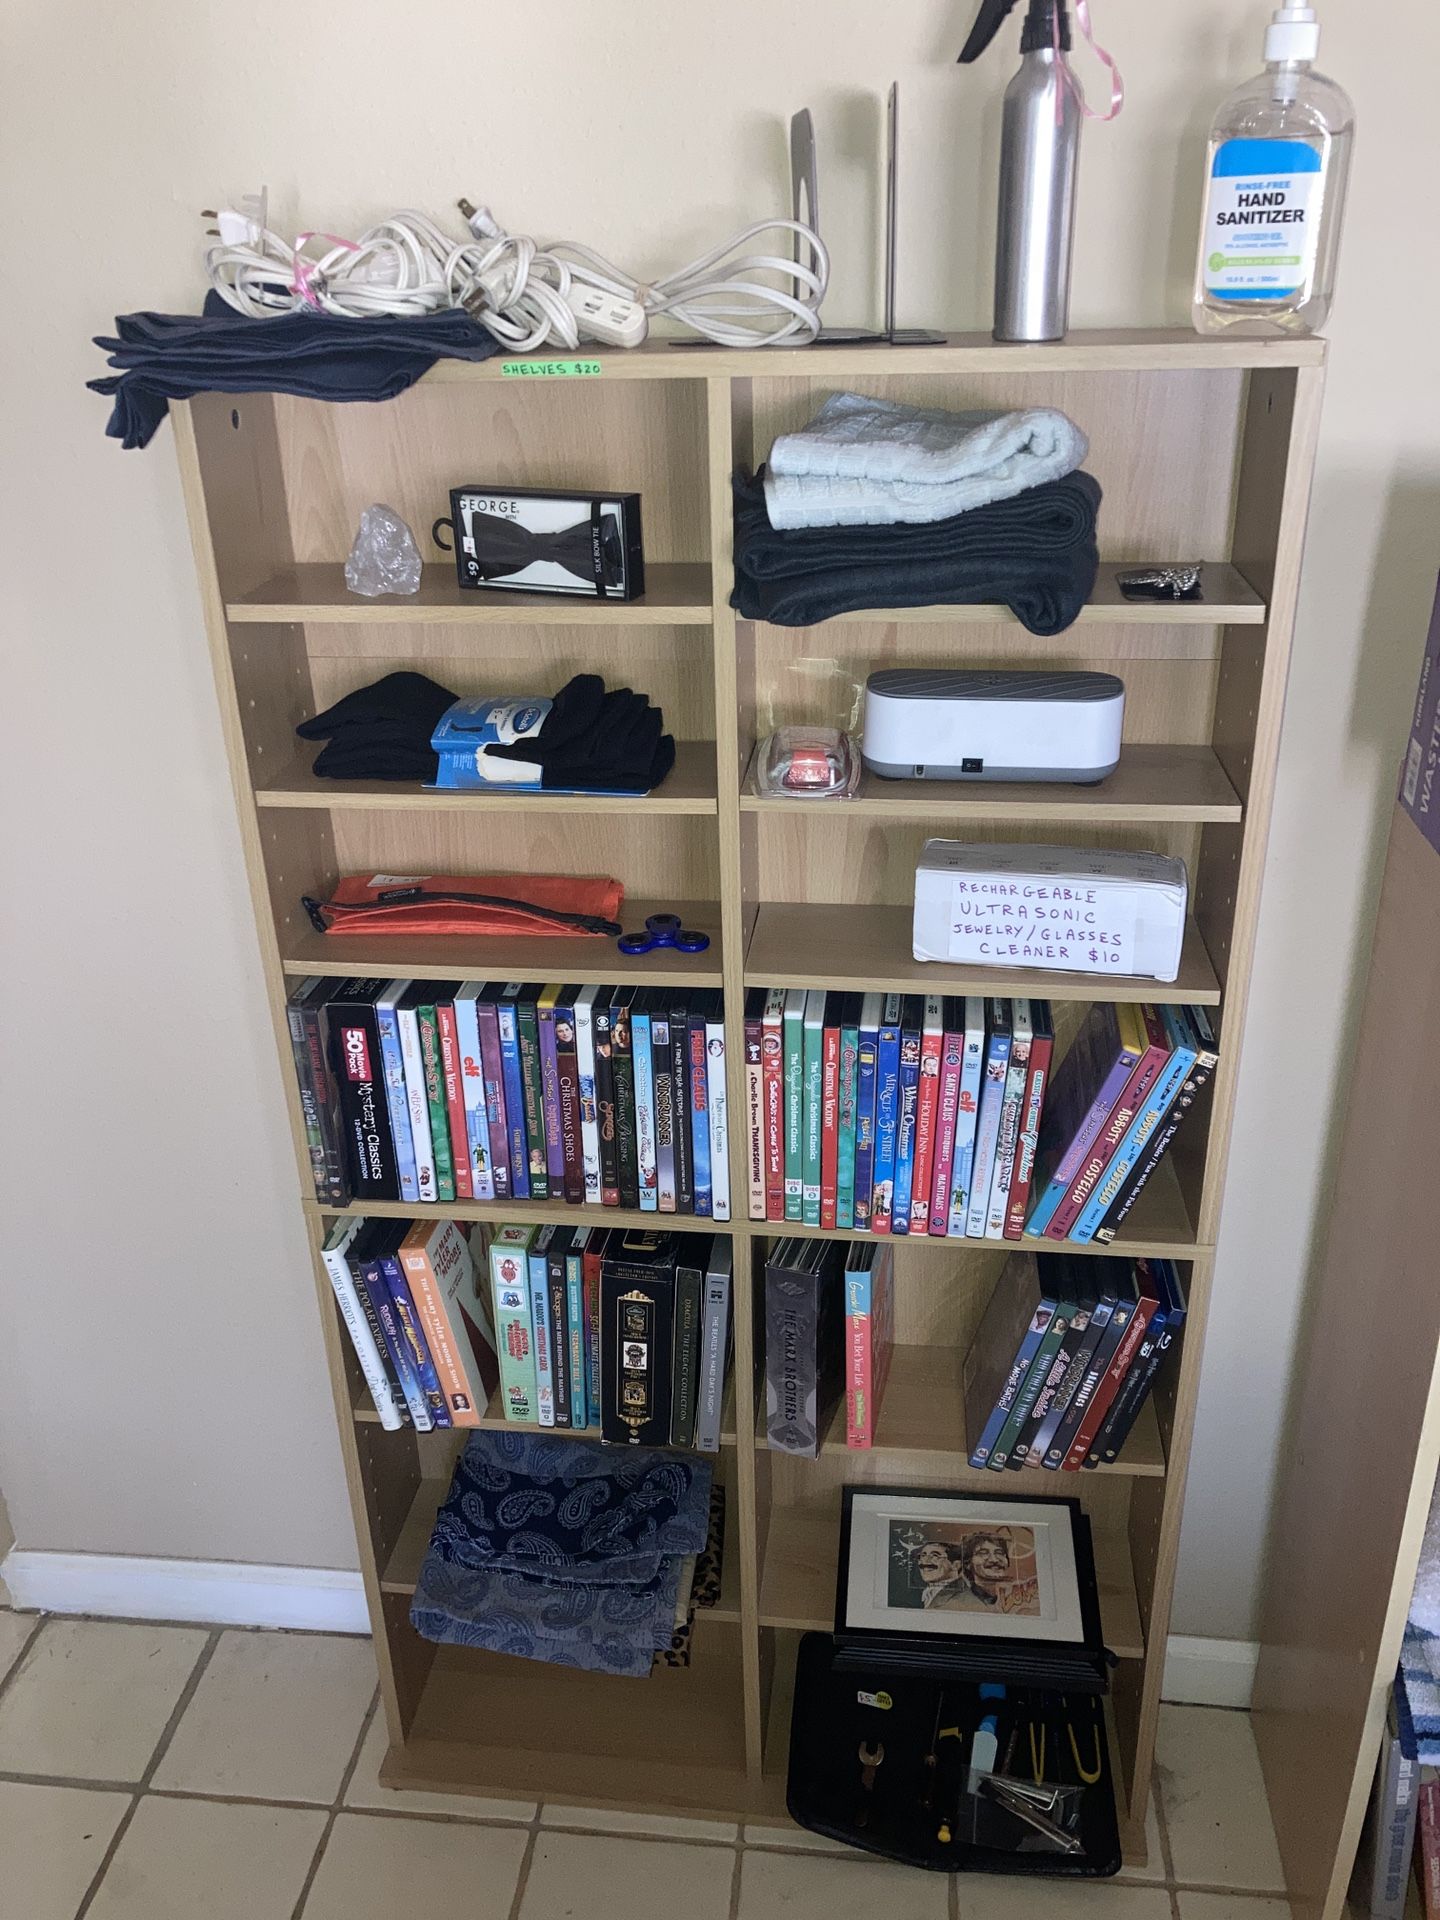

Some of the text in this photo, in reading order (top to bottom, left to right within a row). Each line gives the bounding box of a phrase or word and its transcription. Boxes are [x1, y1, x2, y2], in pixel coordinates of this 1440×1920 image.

[1235, 181, 1291, 191] RINSE-FREE
[1238, 192, 1285, 207] HAND
[1216, 209, 1305, 226] SANITIZER
[502, 363, 600, 374] SHELVES $20
[459, 498, 517, 514] GEORGE
[592, 526, 600, 540] TIE
[593, 540, 601, 556] BOW
[1415, 655, 1431, 728] KIRKLAND
[959, 882, 1096, 904] RECHARGEABLE
[960, 903, 1096, 923] ULTRASONIC
[953, 923, 1122, 946] JEWELRY/GLASSES
[979, 942, 1120, 963] CLEANER $10
[346, 1029, 364, 1053] 50
[347, 1052, 358, 1074] Pack
[356, 1053, 366, 1079] Movie
[441, 1037, 457, 1102] CHRISTMAS VACATION
[463, 1056, 478, 1077] elf
[690, 1029, 708, 1112] FRED CLAUS
[523, 1055, 539, 1136] WILLIAMS CHRISTMAS SHOW
[544, 1068, 557, 1102] SIMPSONS
[824, 1061, 837, 1128] CHRISTMAS VACATION
[903, 1085, 917, 1113] White
[614, 1071, 631, 1162] CHRISTMAS BLESSING
[656, 1073, 672, 1146] WINDRUNNER
[790, 1053, 799, 1155] The Christmas Classics
[809, 1061, 819, 1162] The Christmas Classics
[879, 1072, 896, 1164] MIRACLE STREET
[919, 1100, 932, 1136] HOLIDAY
[959, 1090, 977, 1114] elf
[357, 1082, 383, 1180] Mystery Classics
[559, 1076, 575, 1162] CHRISTMAS SHOES
[749, 1076, 761, 1183] Charlie Brown THANKSGIVING
[1017, 1070, 1044, 1184] CLASSIC COMEDY Christmas
[1131, 1110, 1159, 1147] ABBOTT
[353, 1118, 368, 1180] 12-DVD COLLECTION
[900, 1114, 915, 1160] Christmas
[918, 1136, 930, 1154] INN
[934, 1072, 957, 1211] SANTA CLAUS conquers MARTIANS
[1072, 1107, 1133, 1204] ABBOTT COSTELLO
[1098, 1160, 1129, 1206] COSTELLO
[1116, 1125, 1178, 1221] The Beatles Fun with the Fab Four
[437, 1222, 454, 1252] MARY
[329, 1267, 344, 1295] JAMES
[352, 1270, 389, 1360] THE POLAR EXPRESS
[379, 1304, 397, 1337] RUDOLPH
[535, 1302, 545, 1326] MAGOO'S
[711, 1315, 720, 1328] THE
[419, 1277, 431, 1294] THE
[425, 1293, 438, 1316] MARY
[432, 1316, 447, 1346] TYLER
[441, 1343, 455, 1370] MOORE
[448, 1368, 461, 1390] SHOW
[536, 1326, 547, 1355] CHRISTMAS
[570, 1328, 580, 1366] STEAMBOAT
[591, 1333, 600, 1362] ULTIMATE
[710, 1328, 719, 1351] BEATLES
[851, 1309, 867, 1386] Marx You Bet Your Life
[538, 1355, 548, 1372] CAROL
[556, 1344, 564, 1367] BEHIND
[679, 1298, 693, 1421] DRACULA THE LEGACY COLLECTION
[709, 1360, 717, 1376] HARD
[784, 1309, 798, 1422] THE MARX BROTHERS
[557, 1378, 565, 1404] MAYHEM
[572, 1367, 581, 1382] BILL
[591, 1362, 600, 1395] COLLECTION
[707, 1376, 716, 1395] DAY'S
[998, 1358, 1030, 1413] No MORE BATHS!
[1031, 1349, 1071, 1419] A Little Inside
[1052, 1350, 1093, 1411] WINDRUNNER
[511, 1406, 530, 1415] DVD
[706, 1394, 715, 1416] NIGHT"
